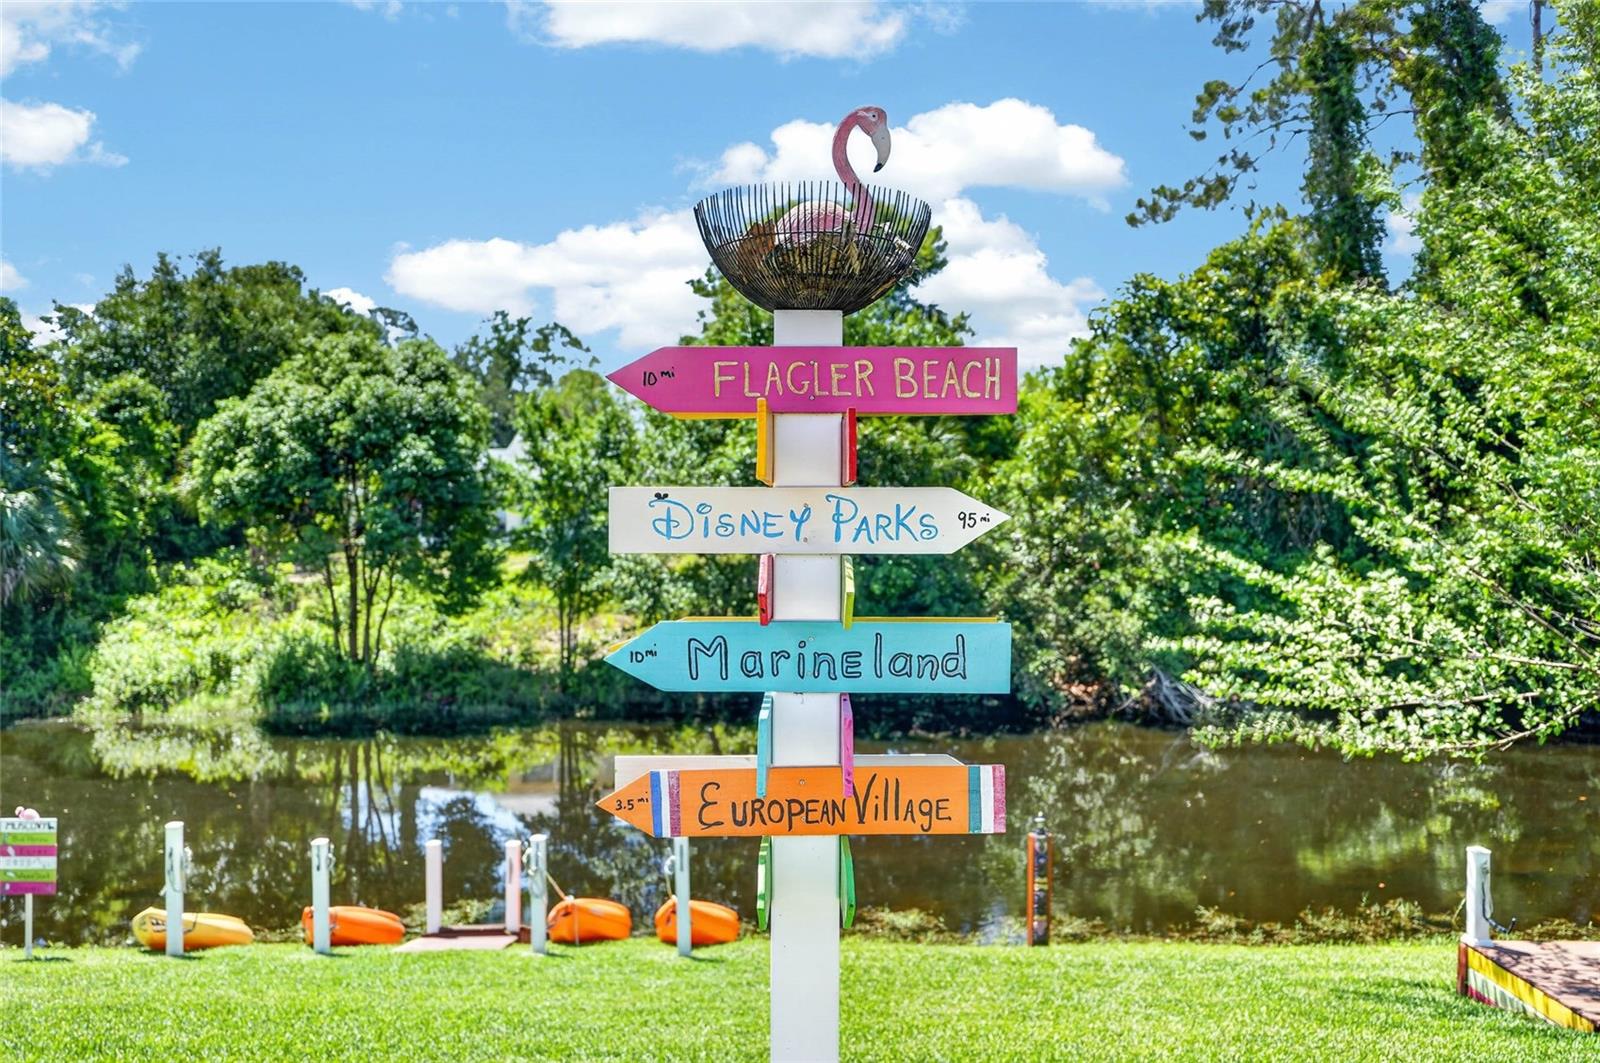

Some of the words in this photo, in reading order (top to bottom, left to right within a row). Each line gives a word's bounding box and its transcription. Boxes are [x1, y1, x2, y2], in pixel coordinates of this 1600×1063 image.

[643, 370, 658, 387] 10
[660, 367, 675, 378] mi
[714, 359, 875, 398] FLAGLER
[895, 357, 1000, 400] BEACH
[826, 495, 939, 543] PARKS
[957, 511, 977, 529] 95
[630, 650, 643, 663] 10
[644, 643, 658, 657] mi
[615, 798, 635, 811] 3.5
[698, 782, 847, 831] EUROPEAN
